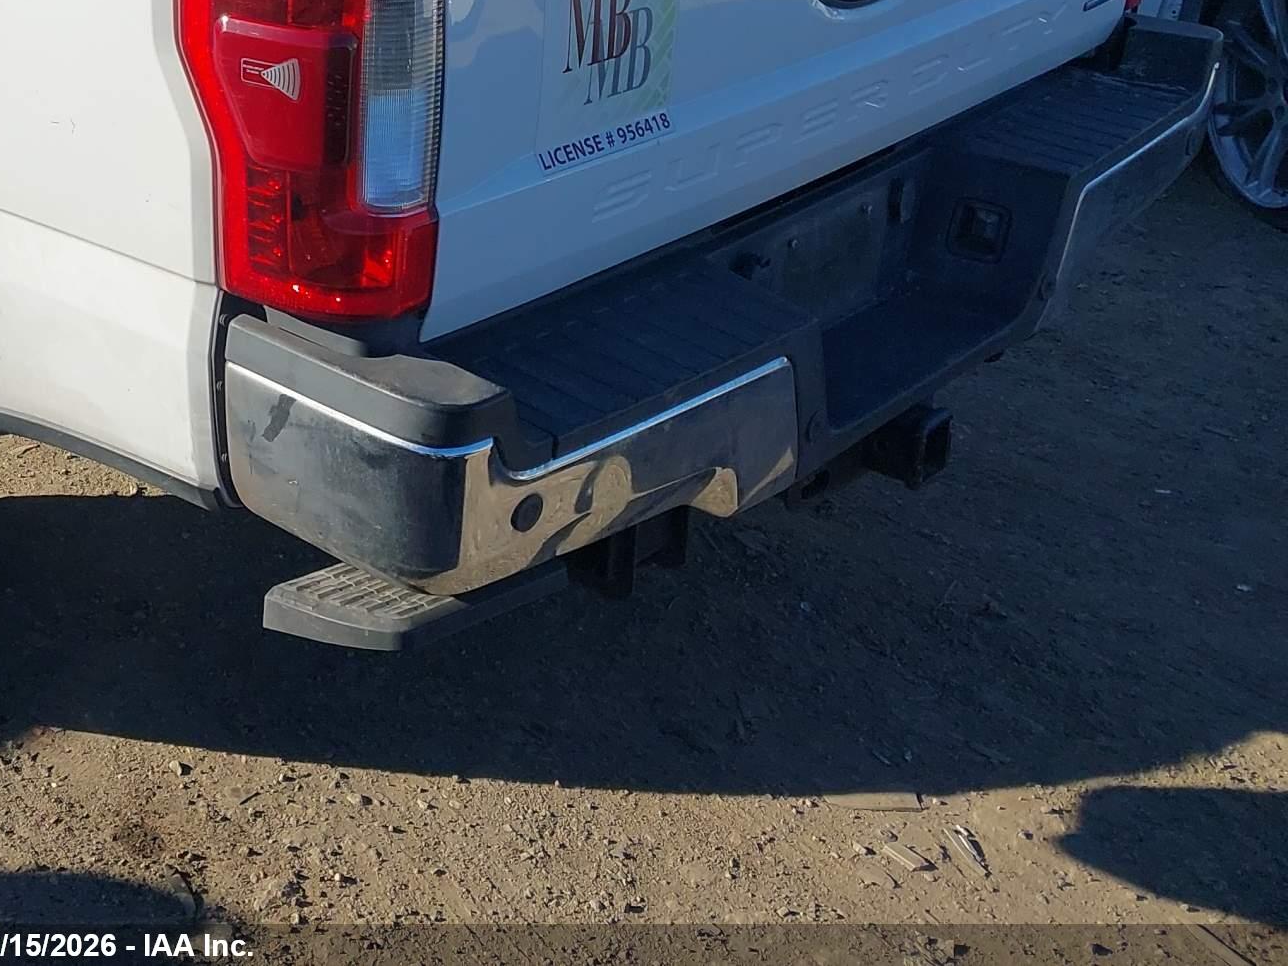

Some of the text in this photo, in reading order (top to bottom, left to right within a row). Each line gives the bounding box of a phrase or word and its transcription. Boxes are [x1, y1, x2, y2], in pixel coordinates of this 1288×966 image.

[538, 134, 605, 171] LICENSE
[616, 112, 671, 145] 956418
[592, 79, 888, 223] SUPER
